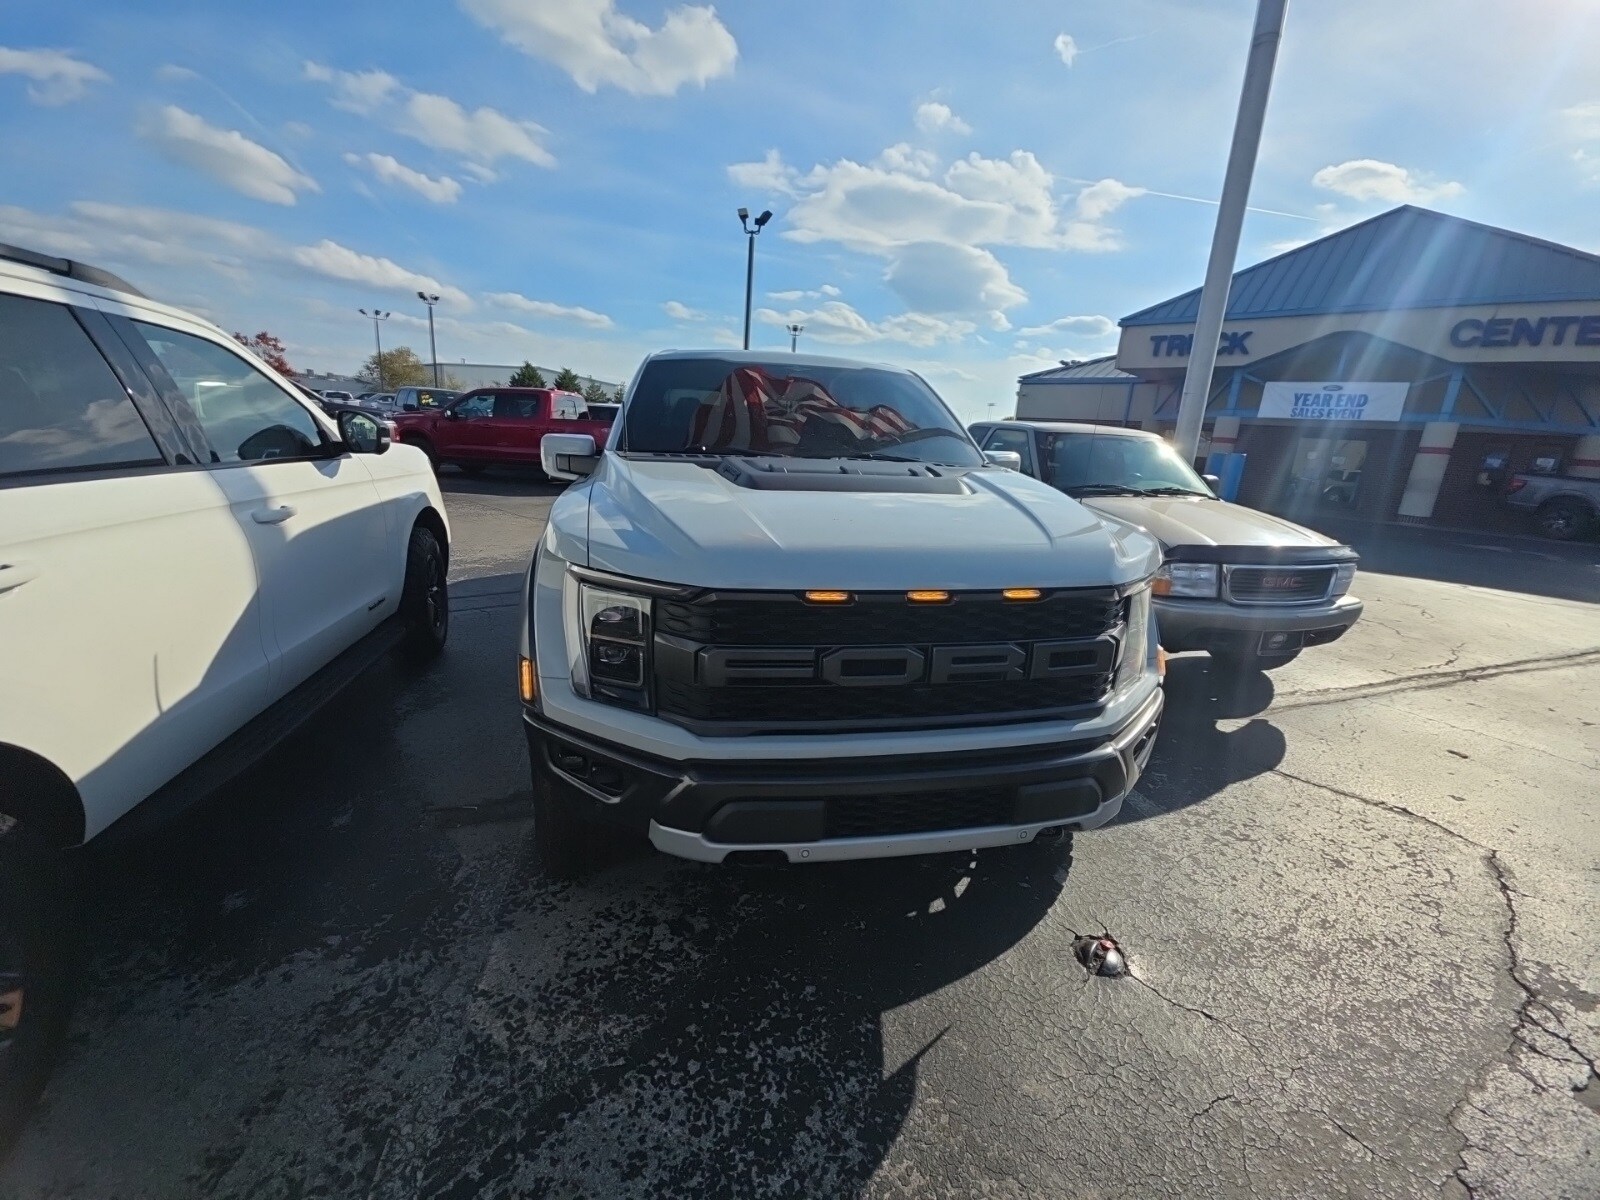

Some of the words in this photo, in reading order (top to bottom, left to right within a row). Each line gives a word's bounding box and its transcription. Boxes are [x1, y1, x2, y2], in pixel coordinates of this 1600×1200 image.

[1150, 331, 1253, 357] TRK
[1293, 392, 1333, 407] YEAR
[1334, 393, 1369, 408] END
[1290, 407, 1325, 418] SALES
[1325, 408, 1365, 419] EVENT
[1261, 576, 1303, 588] GMC
[700, 634, 1118, 688] FORD
